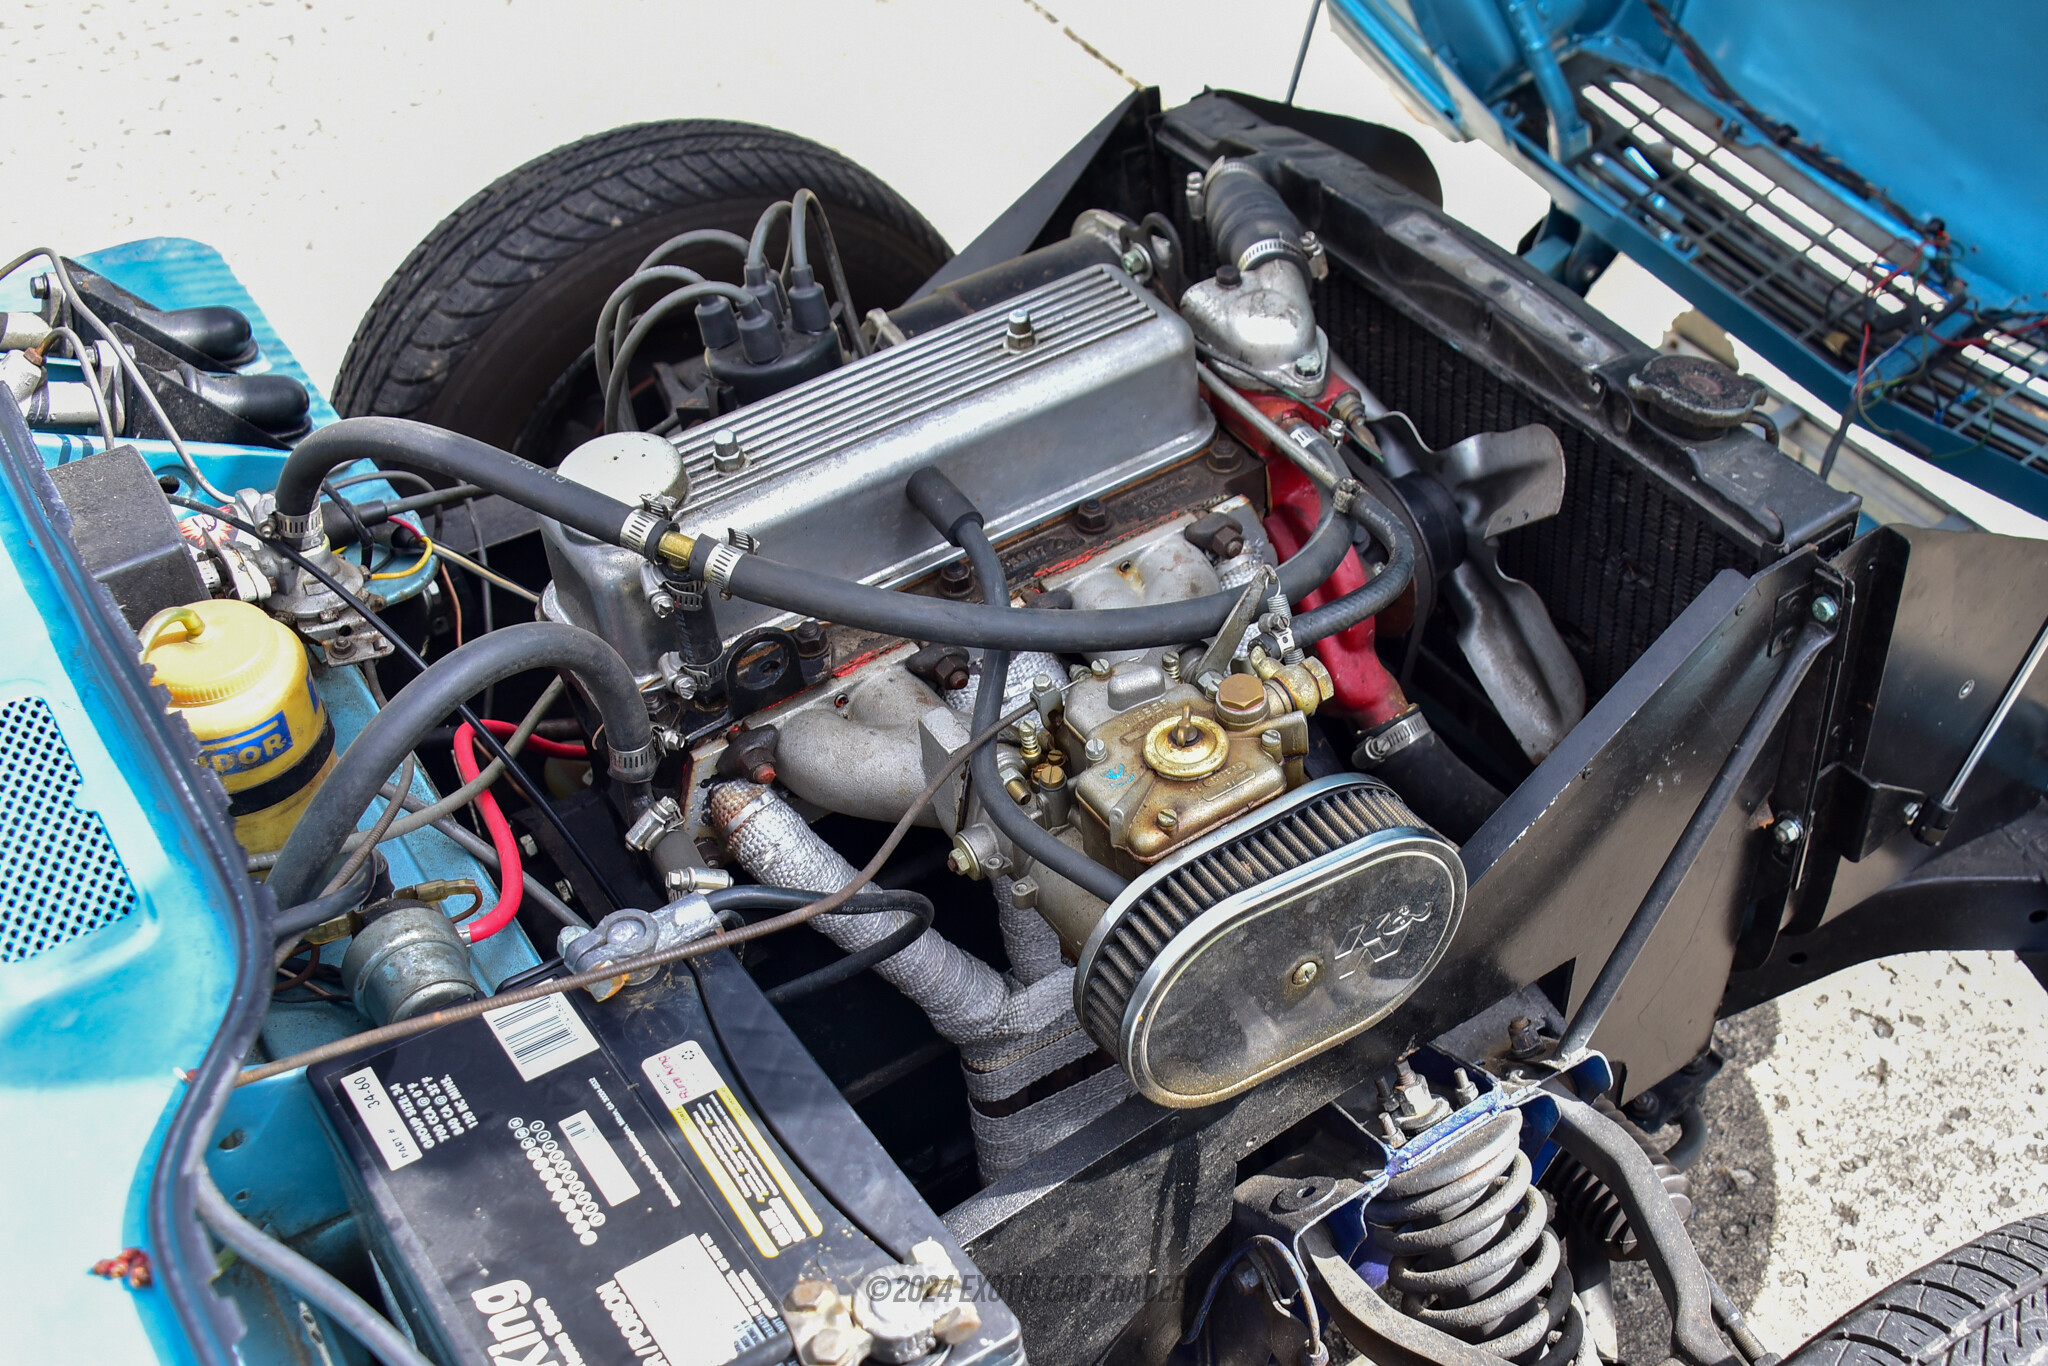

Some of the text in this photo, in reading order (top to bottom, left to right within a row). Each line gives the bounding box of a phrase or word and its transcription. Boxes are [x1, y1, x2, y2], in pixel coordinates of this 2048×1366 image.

[354, 1077, 380, 1108] 34-60
[390, 1083, 404, 1096] 34
[417, 1097, 430, 1107] @
[434, 1095, 447, 1105] @
[454, 1099, 469, 1113] RC
[423, 1106, 439, 1125] CCA
[440, 1104, 454, 1119] CA
[462, 1111, 478, 1129] 120
[409, 1117, 435, 1149] GROUP
[433, 1124, 450, 1143] 700
